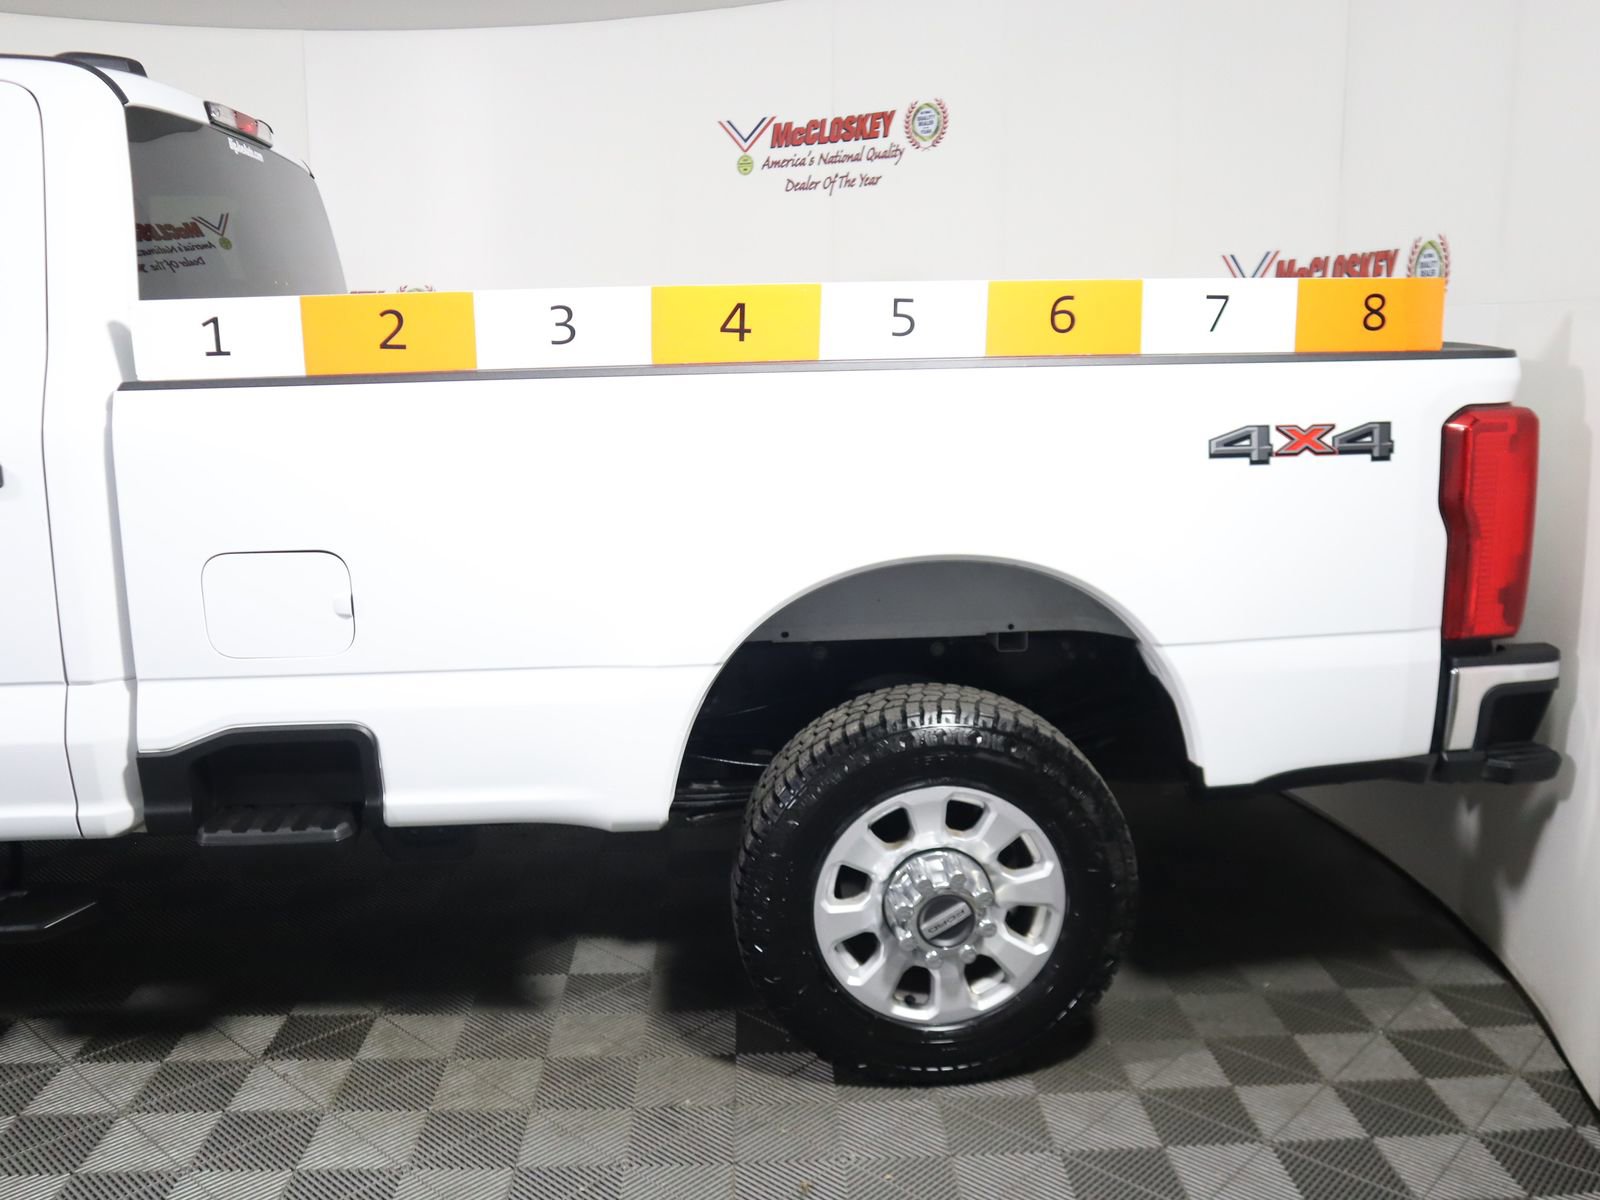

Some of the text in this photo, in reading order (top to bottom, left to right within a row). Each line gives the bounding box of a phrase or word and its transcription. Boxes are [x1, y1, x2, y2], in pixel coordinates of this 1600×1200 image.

[770, 109, 897, 149] McCLOSKEY
[761, 150, 815, 170] America's
[817, 145, 866, 166] National
[866, 143, 906, 166] Quality
[784, 172, 882, 196] Dealer Of The Year
[203, 293, 1386, 356] 1 2 3 4 5 6 7 8
